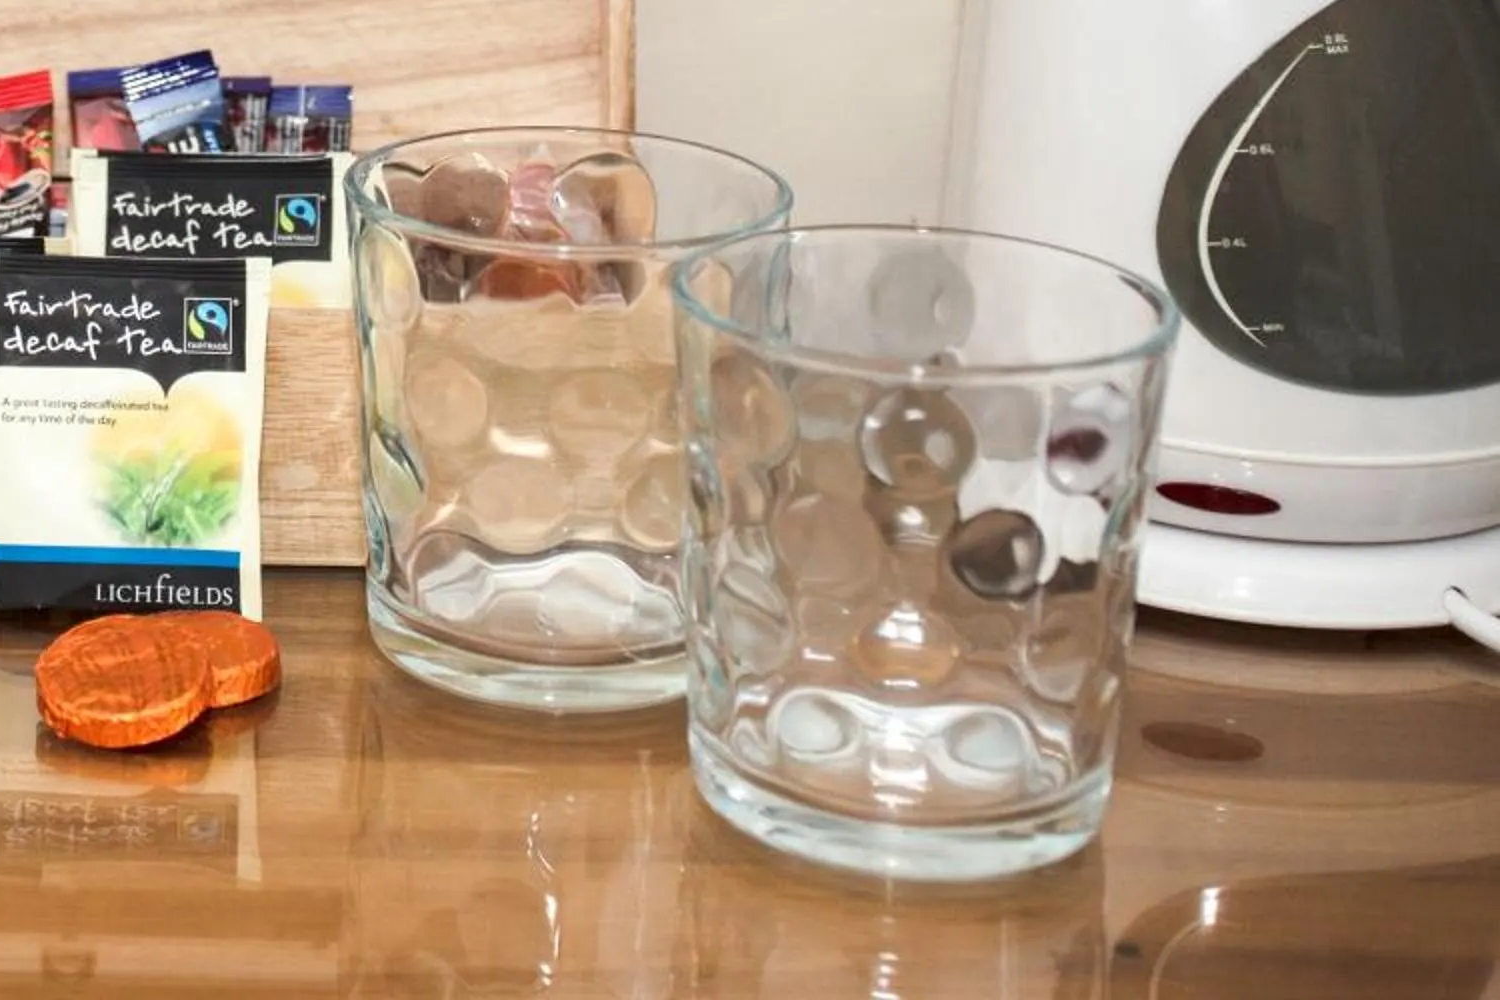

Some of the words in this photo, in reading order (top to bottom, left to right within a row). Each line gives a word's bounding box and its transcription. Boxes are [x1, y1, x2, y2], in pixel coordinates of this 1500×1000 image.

[112, 192, 255, 218] Fairtrade
[111, 219, 201, 255] decaf
[213, 222, 273, 248] tea
[4, 290, 160, 320] Fairtrade
[4, 322, 101, 360] decaf
[117, 326, 182, 356] tea
